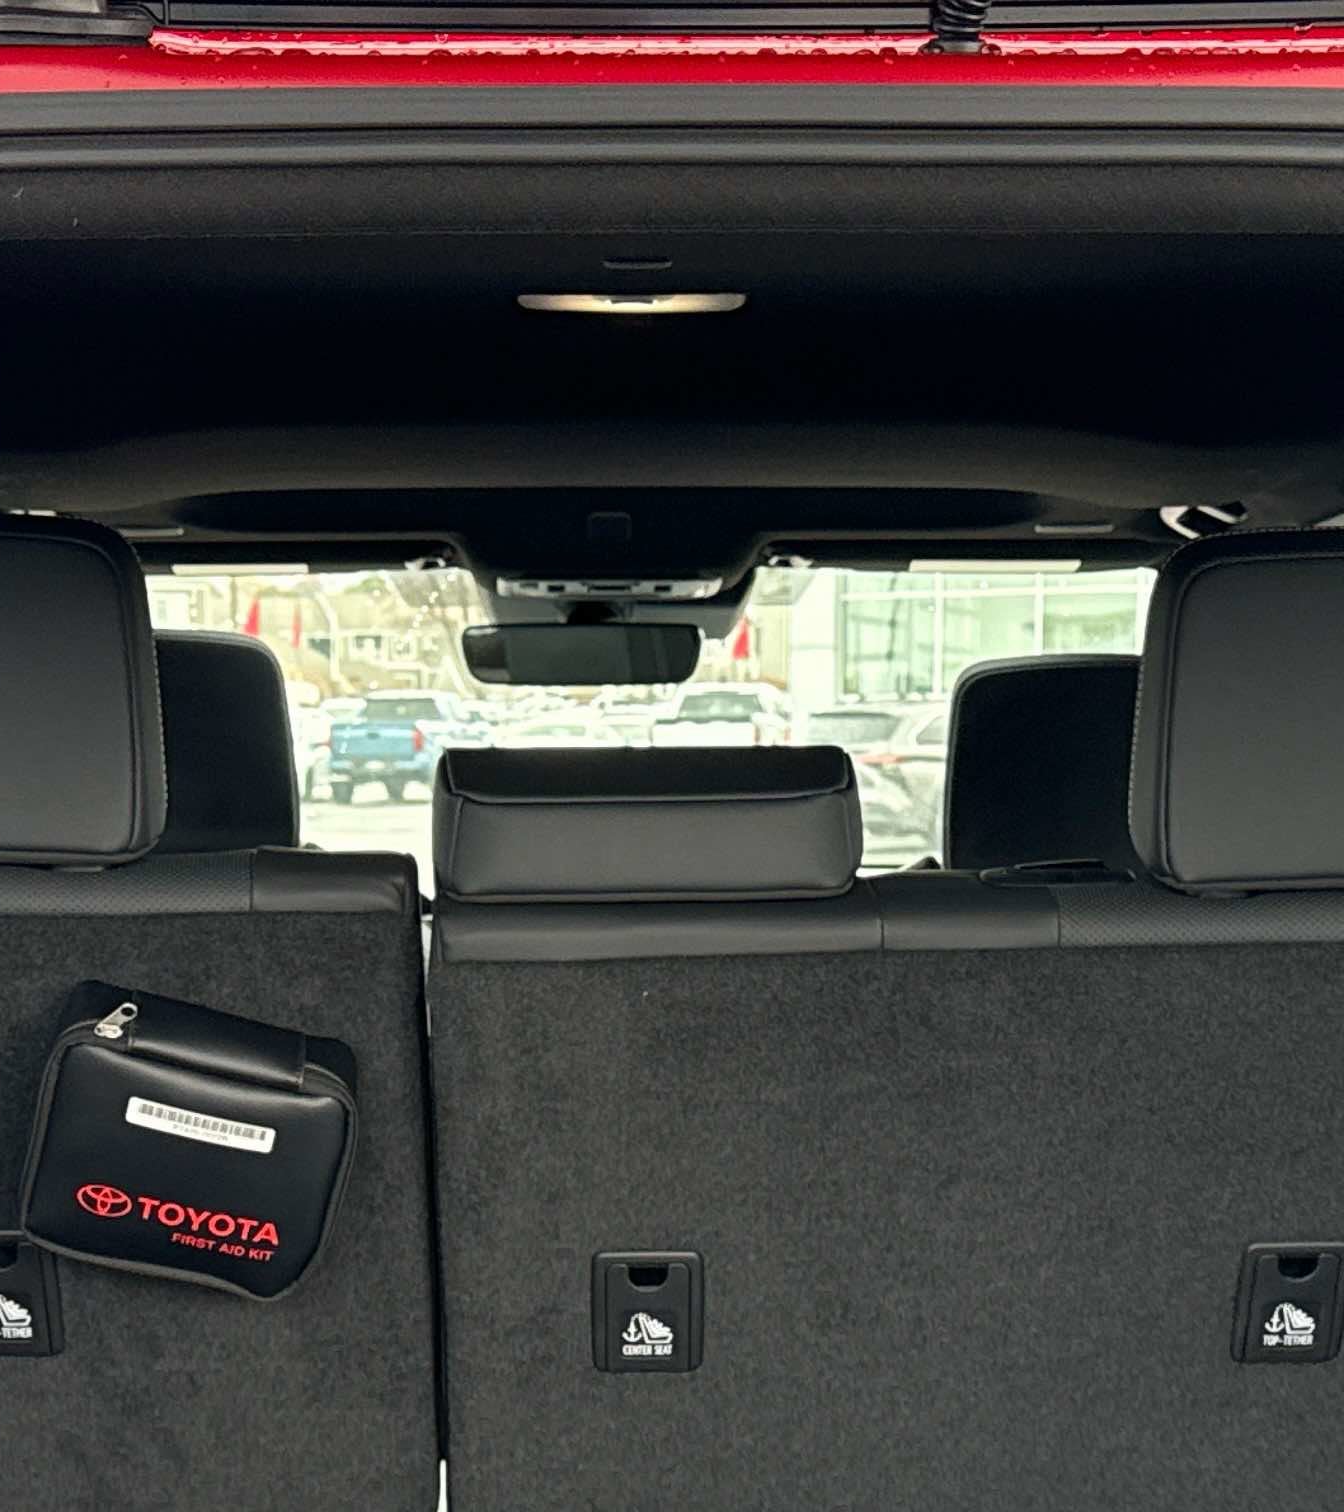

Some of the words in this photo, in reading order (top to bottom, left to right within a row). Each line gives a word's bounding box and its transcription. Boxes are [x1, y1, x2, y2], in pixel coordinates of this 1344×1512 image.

[137, 1195, 280, 1247] TOYOTA
[170, 1232, 214, 1252] FIRST
[218, 1241, 248, 1258] AID
[249, 1245, 276, 1262] KIT
